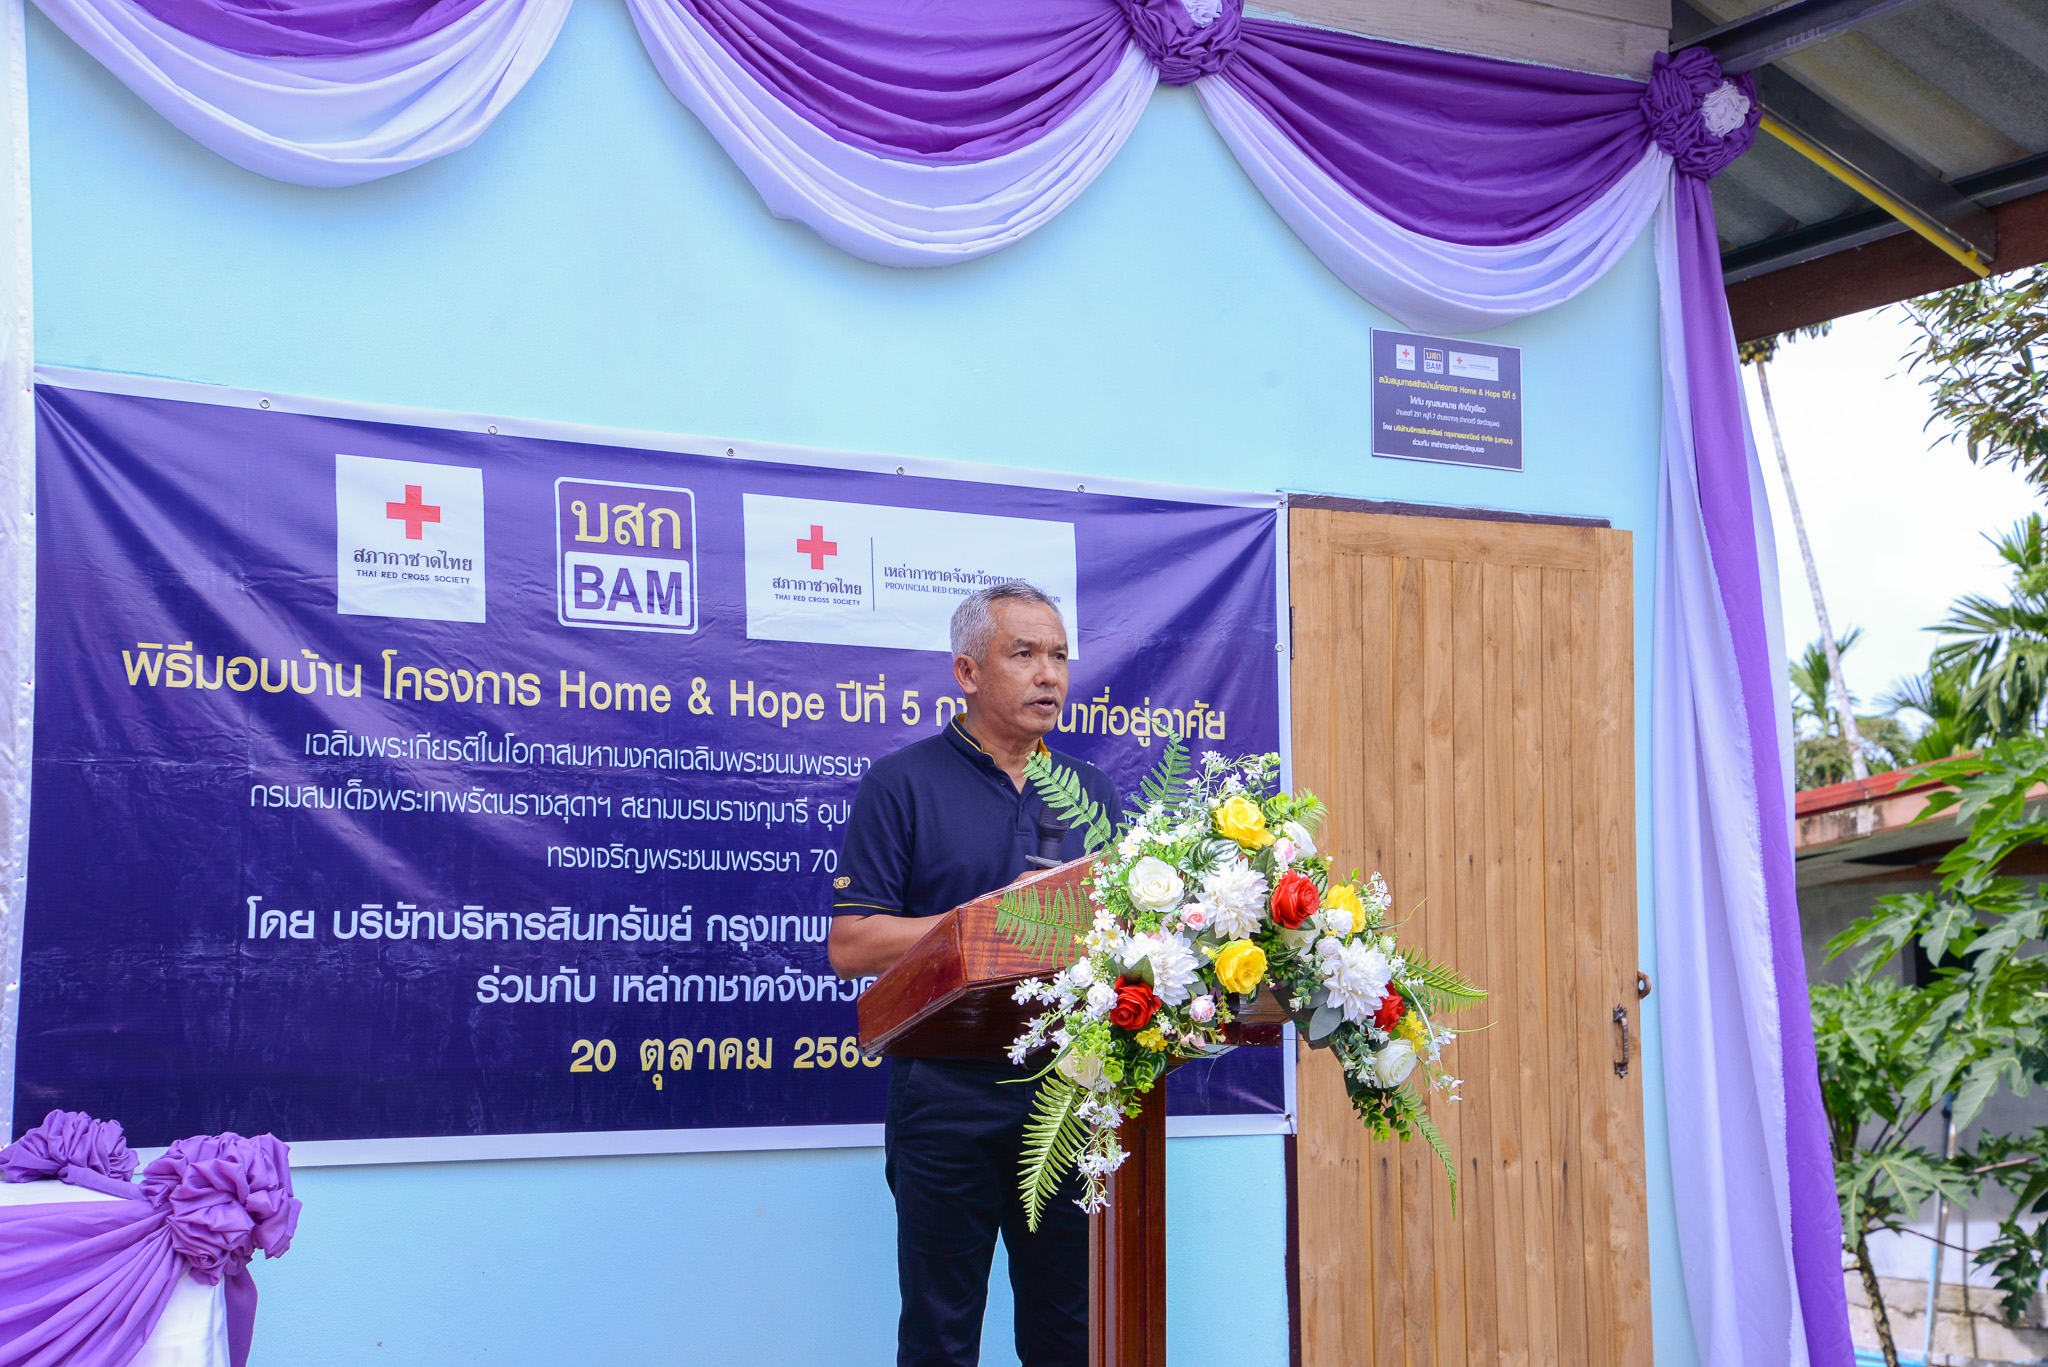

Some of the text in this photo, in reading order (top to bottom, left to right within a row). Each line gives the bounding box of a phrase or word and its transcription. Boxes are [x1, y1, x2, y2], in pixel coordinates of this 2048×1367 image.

[1426, 351, 1442, 361] บสก
[1426, 362, 1442, 371] BAM
[1459, 386, 1477, 395] Home
[1478, 388, 1484, 396] &
[1485, 389, 1501, 399] Hope
[571, 500, 682, 549] บสก
[353, 548, 473, 571] สภากาชาดไทย
[356, 569, 470, 584] THAI RED CROSS SOCIETY
[574, 564, 683, 616] BAM
[772, 577, 862, 595] สภากาชาดไทย
[885, 582, 931, 593] PROVINCIAL
[932, 586, 947, 594] RED
[948, 587, 972, 596] CROSS
[774, 593, 790, 601] THAI
[808, 596, 829, 604] CROSS
[833, 598, 860, 606] SOCIETY
[122, 642, 362, 698] พิธีมอบบ้าน
[382, 649, 541, 706] โครงการ
[560, 670, 672, 713] Home
[688, 677, 714, 716] &
[730, 679, 825, 728] Hope
[836, 674, 886, 723] ปีที่
[901, 691, 922, 726] 5
[250, 779, 851, 832] กรมสมเด็จพระเทพรัตนราชสุดาฯ สยามบรมราชกุมารี อุป
[547, 843, 838, 874] ทรงเจริญพระชนมพรรษา 70
[247, 896, 833, 951] โดย บริษัทบริหารสินทรัพย์ กรุงเทพ
[476, 965, 596, 1003] ร่วมกับ
[570, 1039, 617, 1073] 20
[640, 1037, 773, 1091] ตุลาคม
